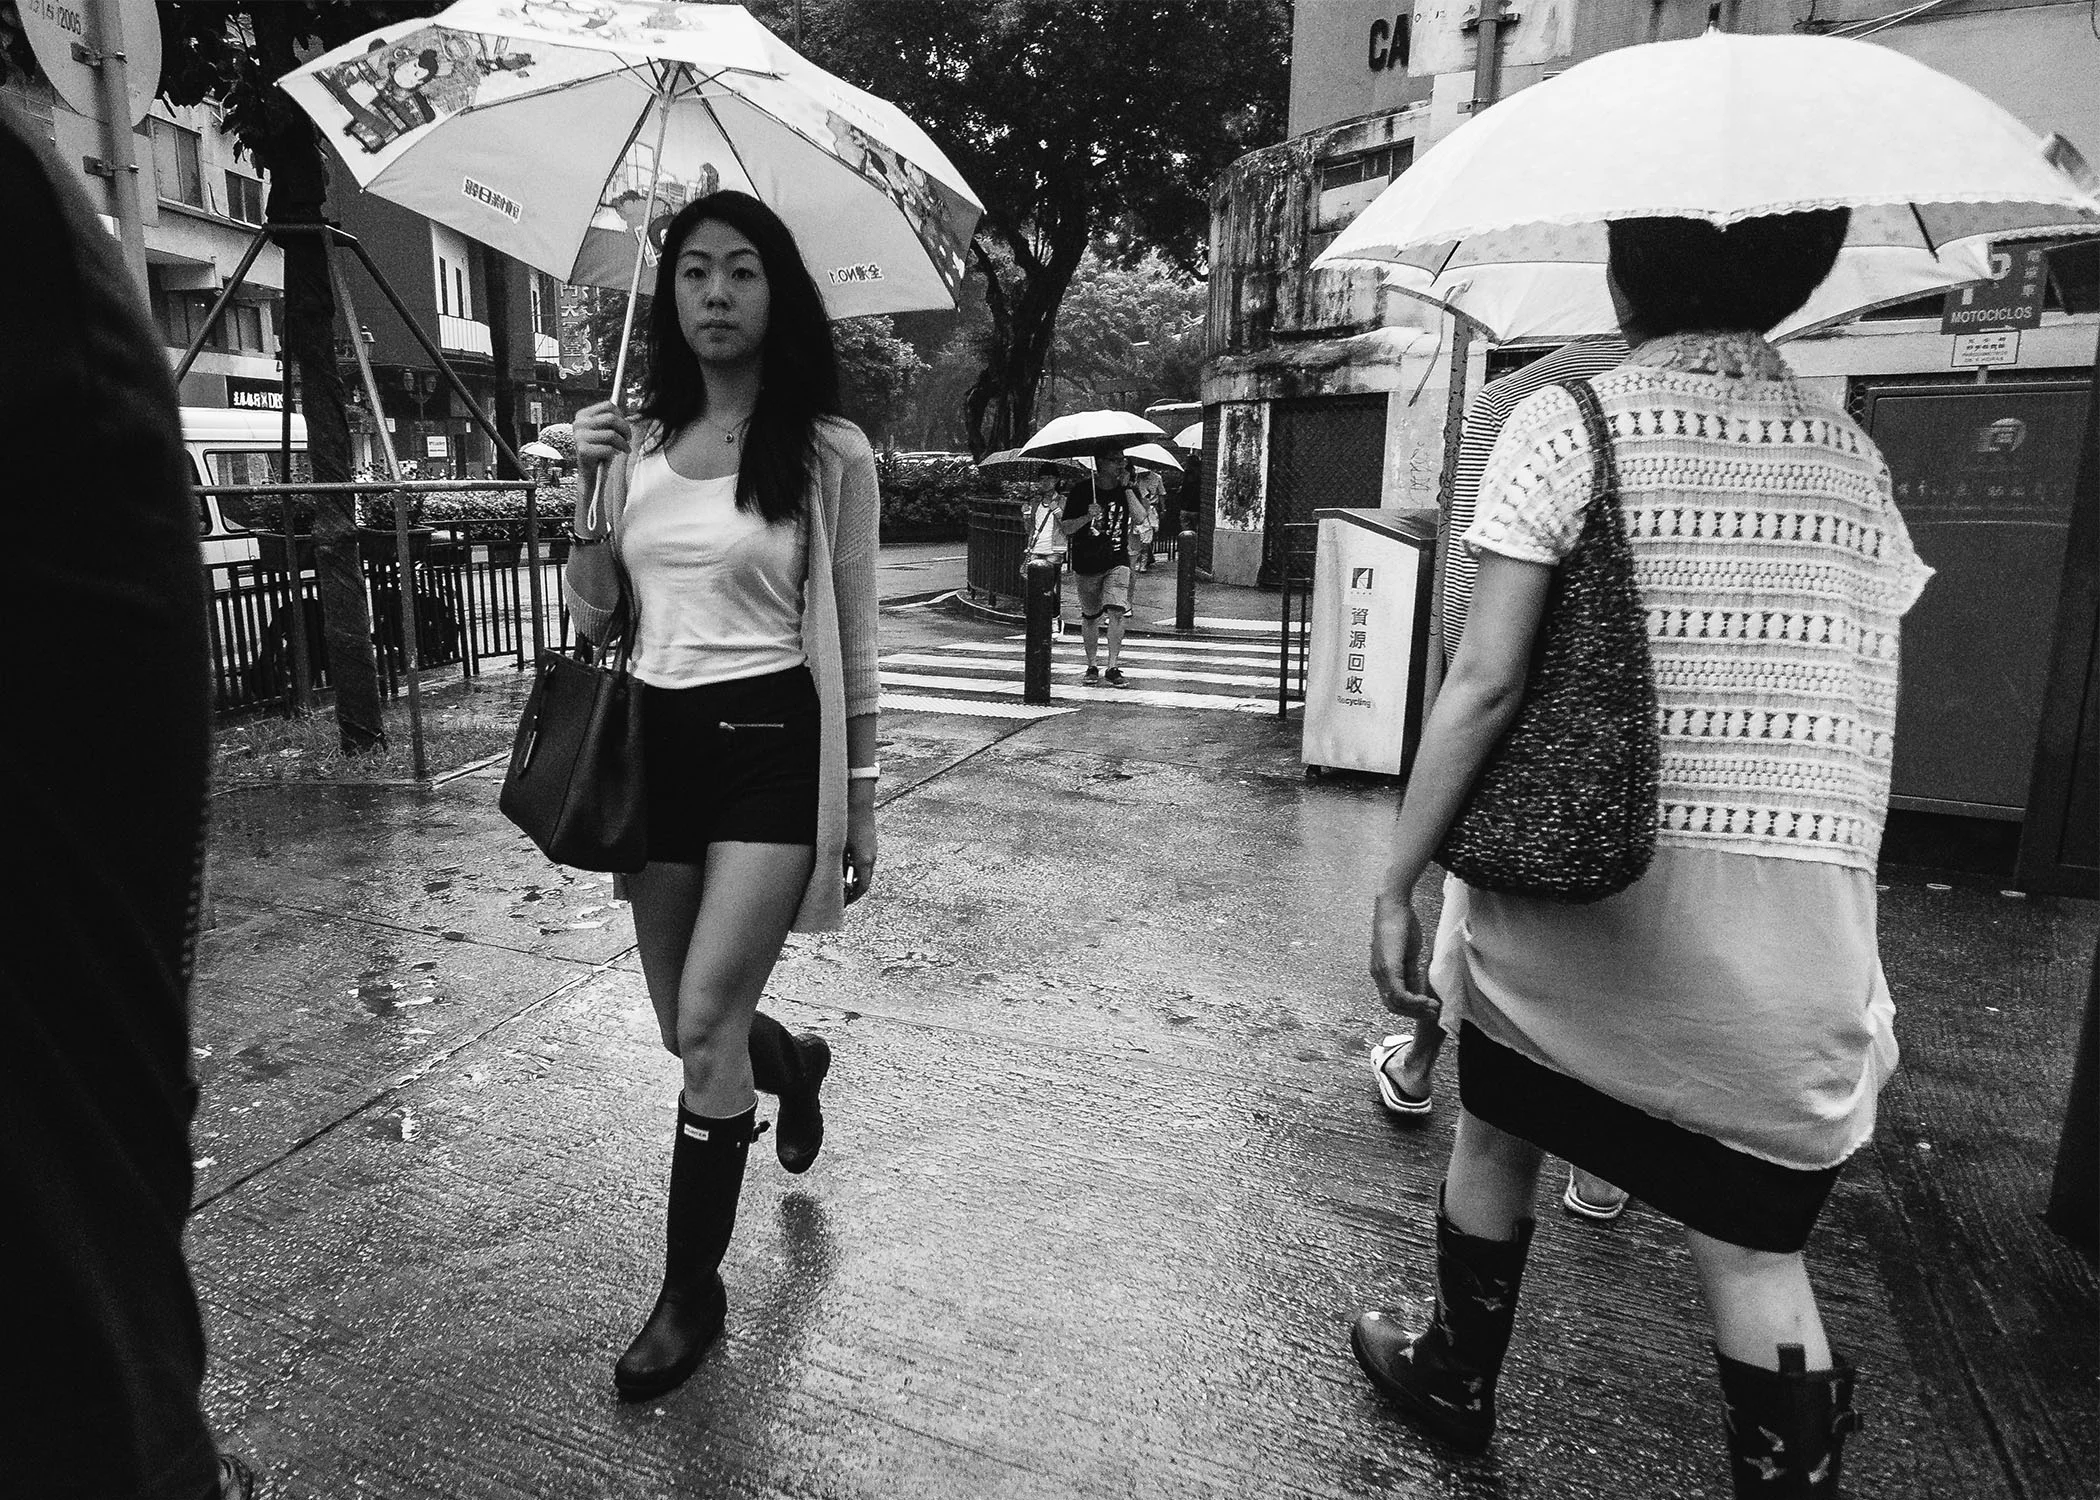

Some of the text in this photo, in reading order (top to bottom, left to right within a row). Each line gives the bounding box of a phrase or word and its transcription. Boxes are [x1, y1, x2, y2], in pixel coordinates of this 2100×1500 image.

[1951, 306, 2033, 323] MOTOCICLOS
[1345, 607, 1369, 694] 資源回收
[1337, 695, 1372, 709] Recycling
